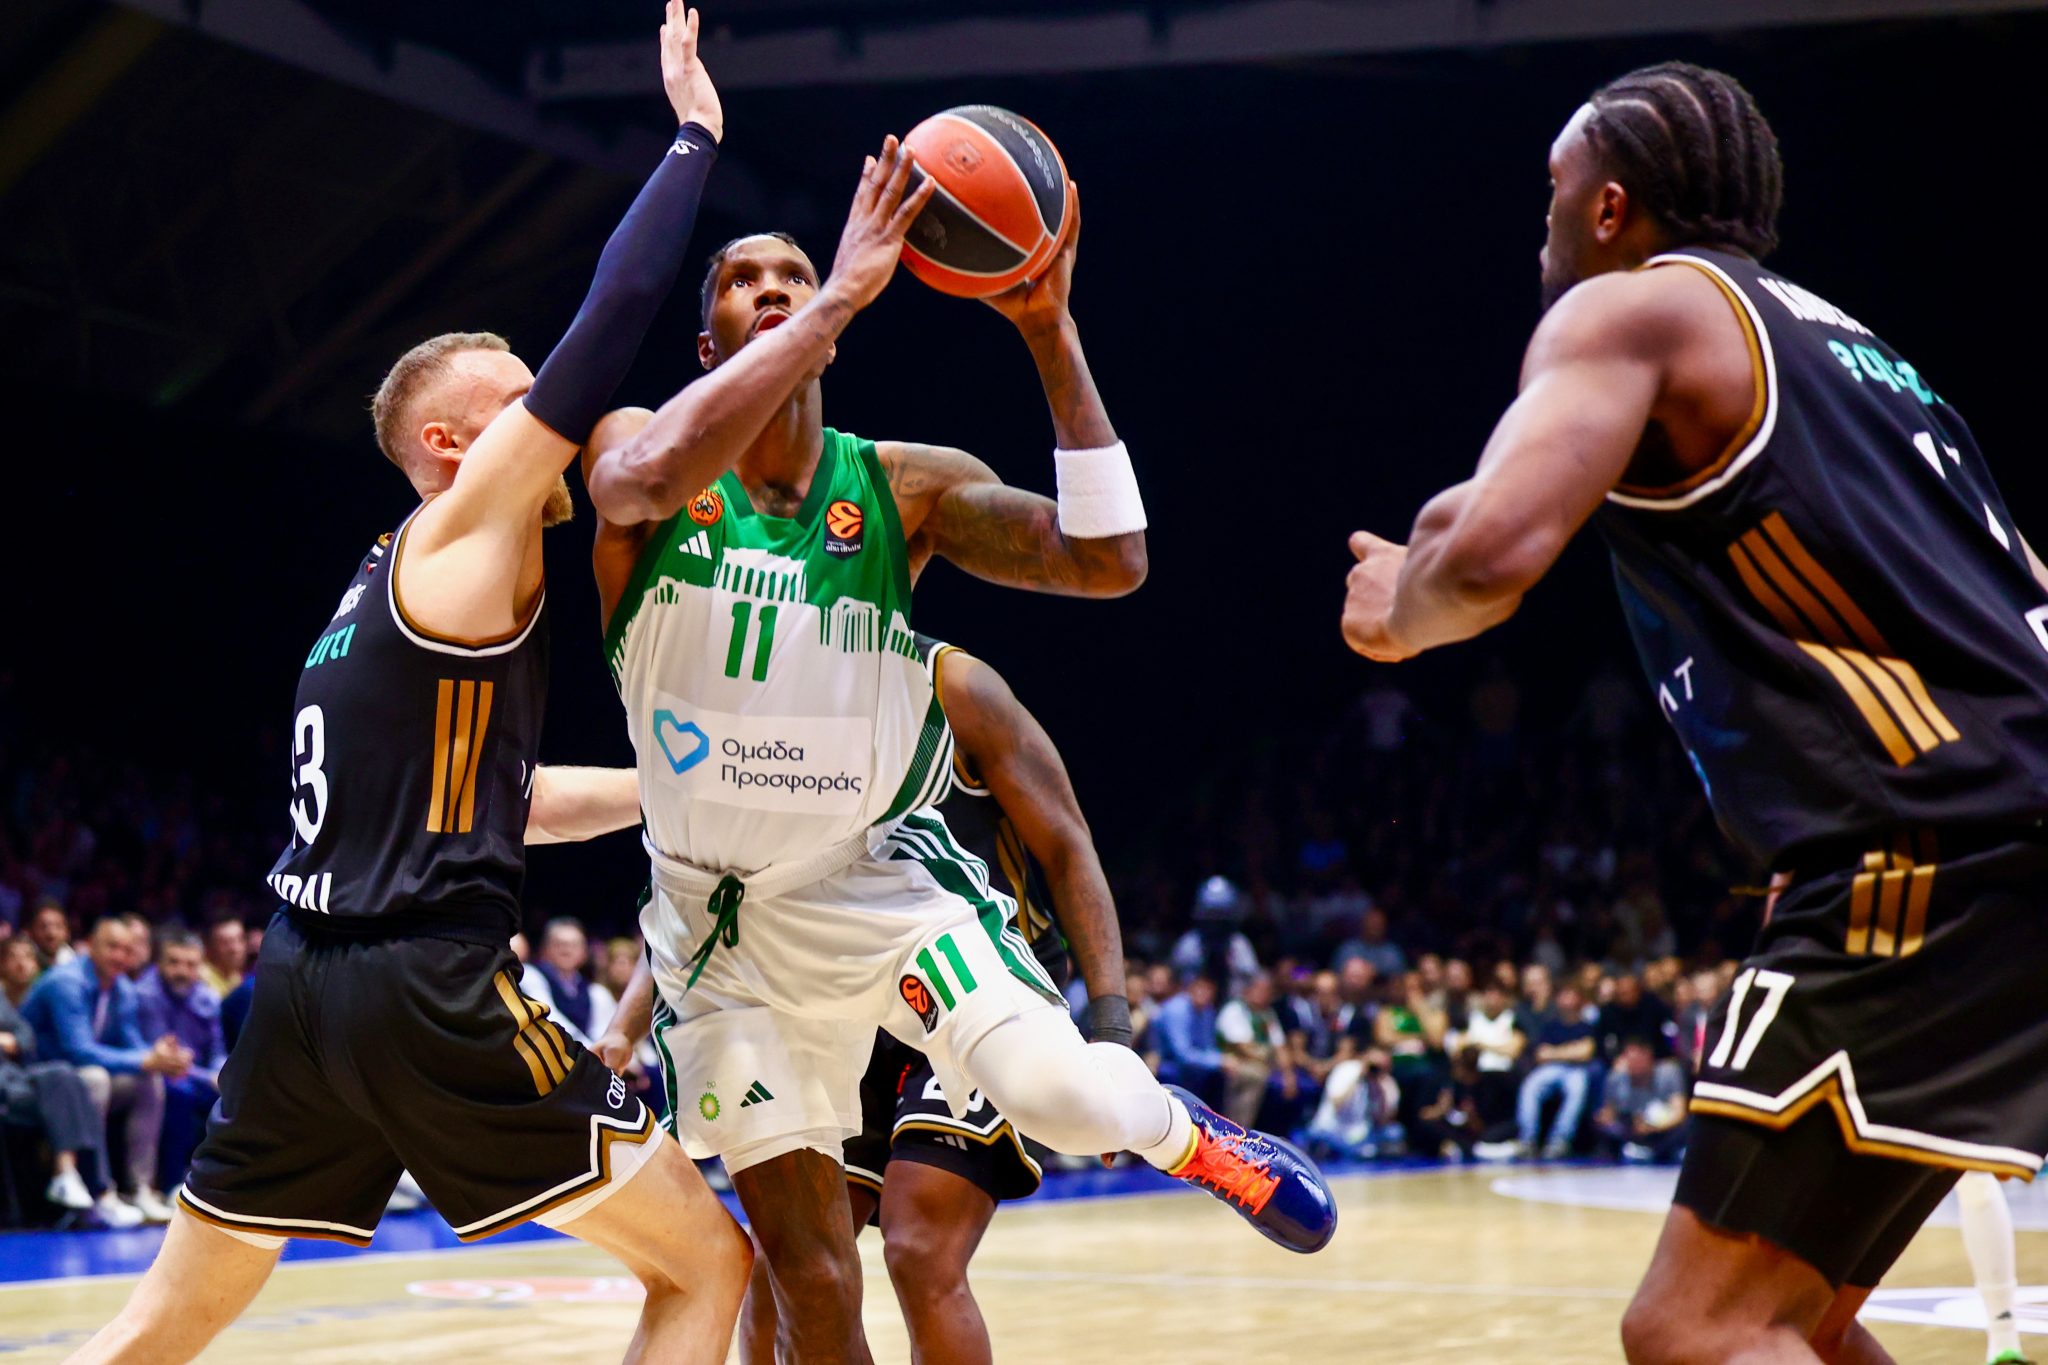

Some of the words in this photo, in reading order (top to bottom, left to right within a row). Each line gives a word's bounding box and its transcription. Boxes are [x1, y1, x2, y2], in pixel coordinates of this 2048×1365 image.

[724, 601, 778, 682] 11
[290, 704, 328, 850] 3
[721, 738, 804, 762] Ομάδα
[721, 765, 862, 795] Προσφοράς
[916, 933, 978, 1012] 11
[1708, 967, 1796, 1071] 17
